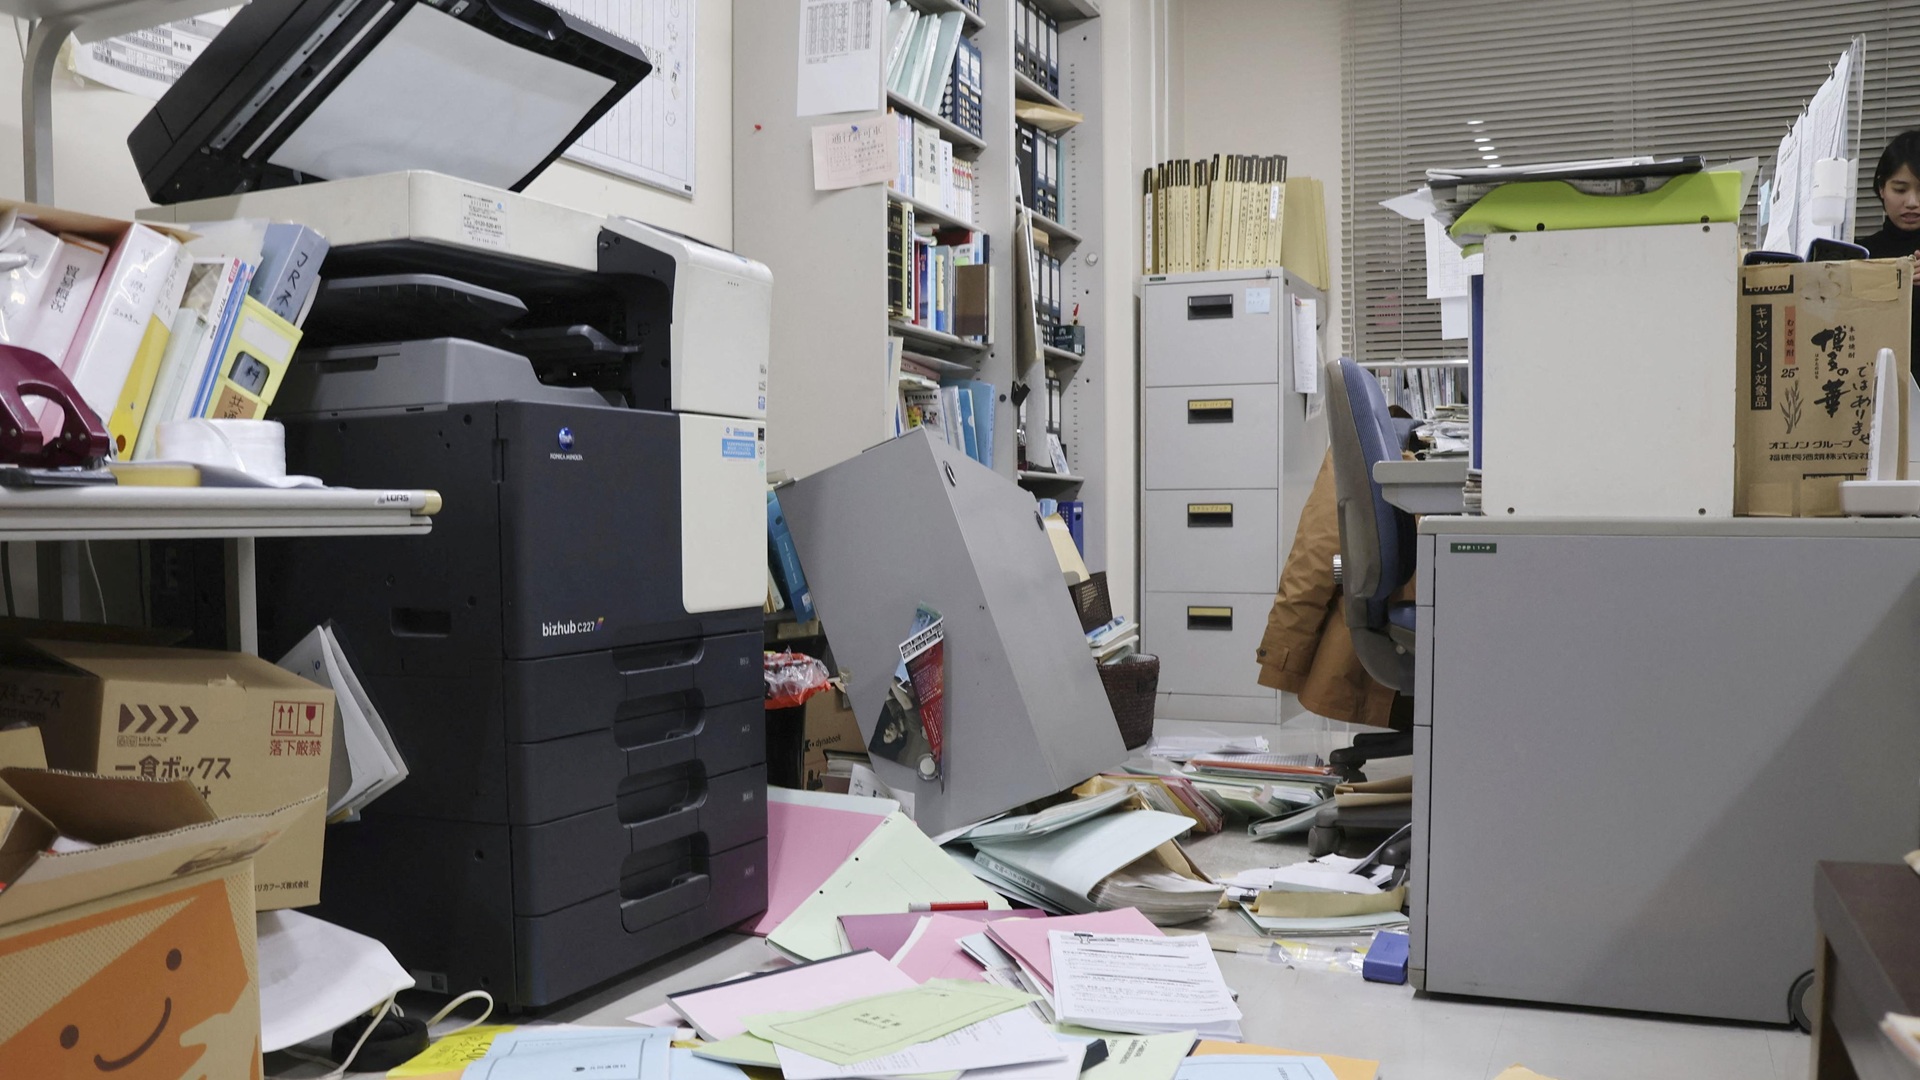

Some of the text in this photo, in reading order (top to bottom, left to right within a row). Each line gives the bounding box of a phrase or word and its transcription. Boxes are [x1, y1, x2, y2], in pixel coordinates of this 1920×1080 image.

[654, 49, 662, 66] 31
[1785, 318, 1796, 358] むぎ焼酎
[1847, 325, 1857, 359] 本格焼酎
[1754, 307, 1768, 408] キャンペーン対象品
[1811, 325, 1851, 418] 博多の華
[1768, 440, 1853, 451] オエノン グループ
[549, 453, 584, 462] KONICA MINOLTA
[542, 619, 595, 637] bizhub C227
[269, 739, 323, 757] 落下厳禁
[115, 755, 232, 779] 一食ボックス
